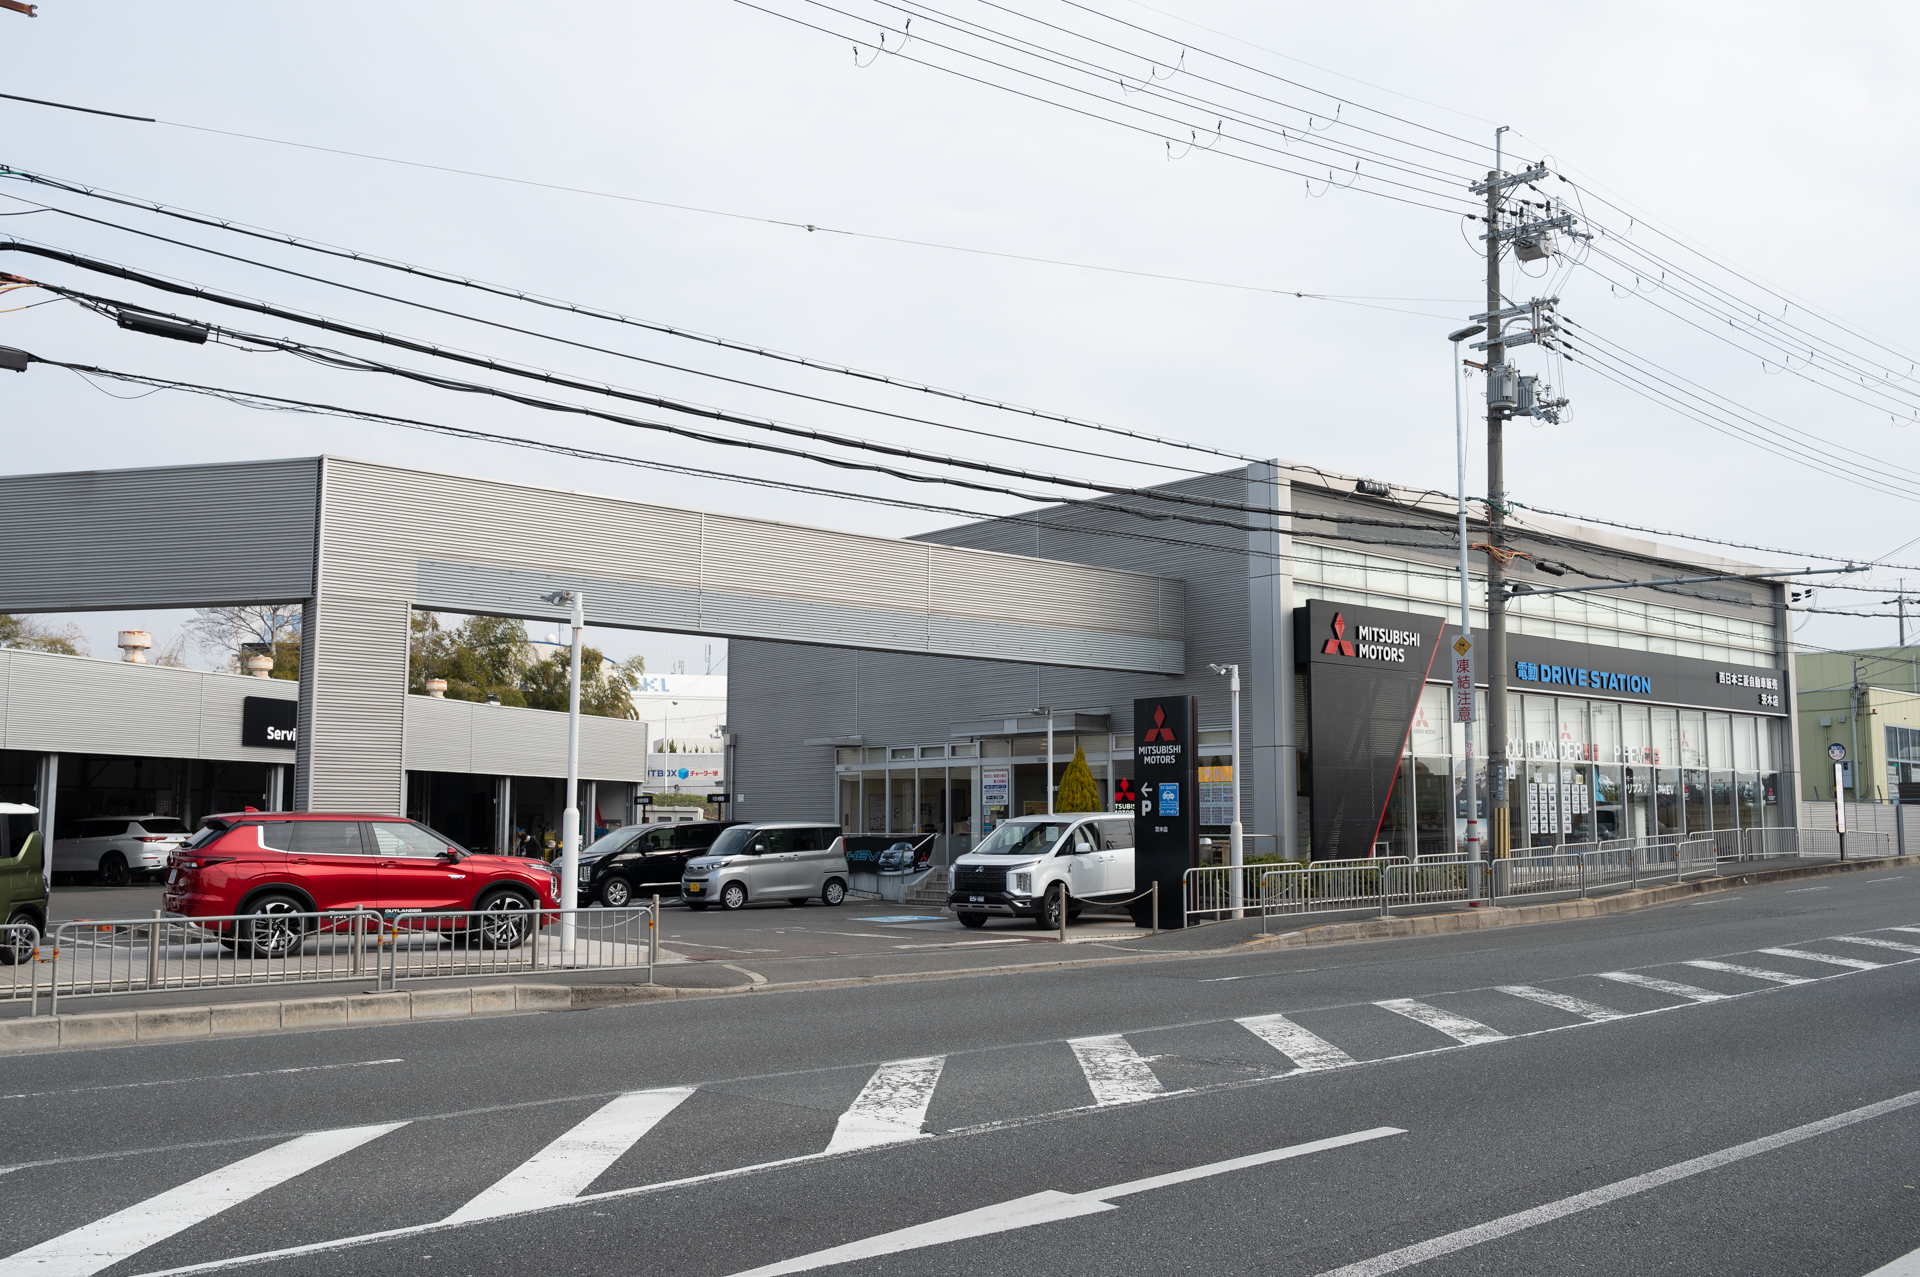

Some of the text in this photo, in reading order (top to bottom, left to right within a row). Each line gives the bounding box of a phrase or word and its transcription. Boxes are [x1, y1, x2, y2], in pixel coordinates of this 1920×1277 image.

[1359, 625, 1420, 647] MITSUBISHI
[1359, 644, 1405, 662] MOTORS
[1517, 661, 1651, 694] 電動 DRIVE STATION
[1719, 671, 1778, 690] 西日本三菱自動車販売
[1456, 658, 1472, 722] 凍結注意
[1761, 694, 1779, 707] 茨木店
[266, 726, 297, 741] Servi
[1138, 745, 1181, 755] MITSUBISHI
[1508, 739, 1582, 761] OUTLANDER
[1144, 755, 1176, 764] MOTORS
[1141, 800, 1152, 816] P
